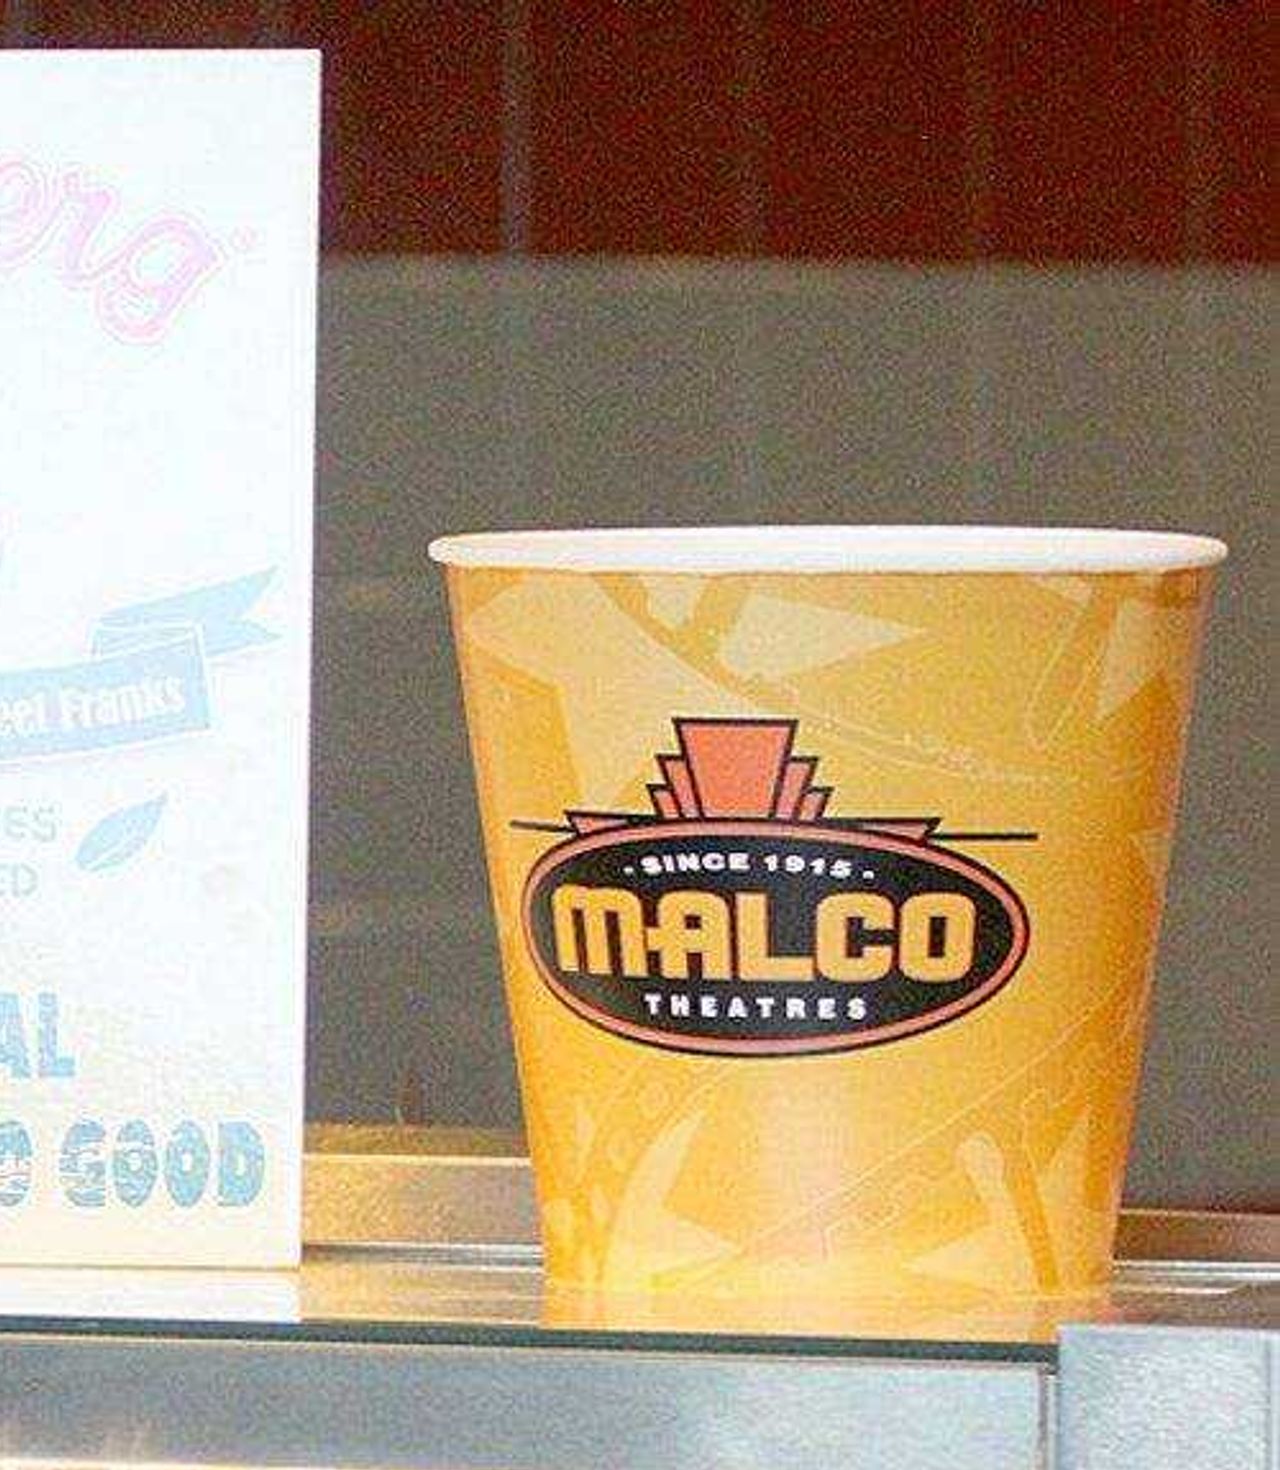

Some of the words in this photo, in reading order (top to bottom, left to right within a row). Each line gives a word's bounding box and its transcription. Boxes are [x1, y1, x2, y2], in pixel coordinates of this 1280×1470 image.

[641, 852, 750, 874] SINCE
[763, 854, 851, 878] 1915
[552, 886, 976, 983] MALCO
[644, 993, 867, 1020] THEATRES
[58, 1118, 266, 1207] GOOD
